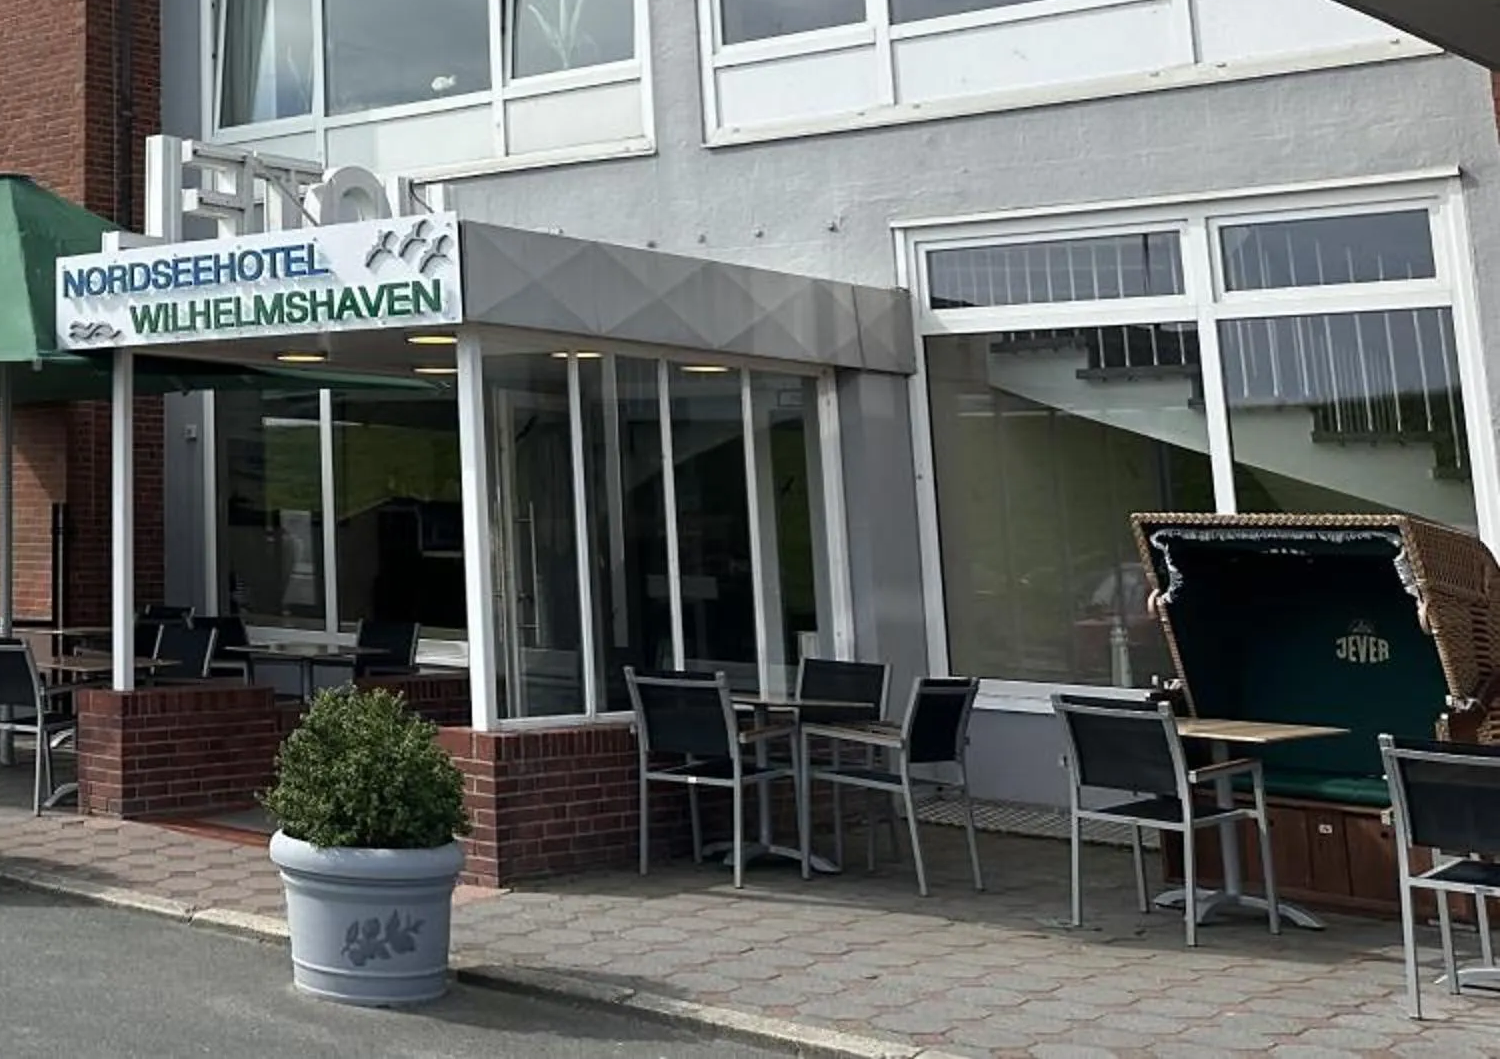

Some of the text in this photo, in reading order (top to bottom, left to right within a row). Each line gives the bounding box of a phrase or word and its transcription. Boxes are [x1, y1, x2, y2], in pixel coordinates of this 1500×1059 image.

[62, 243, 328, 297] NORDSEEHOTEL
[129, 278, 442, 334] WILHELMSHAVEN
[1335, 635, 1390, 664] JEVER
